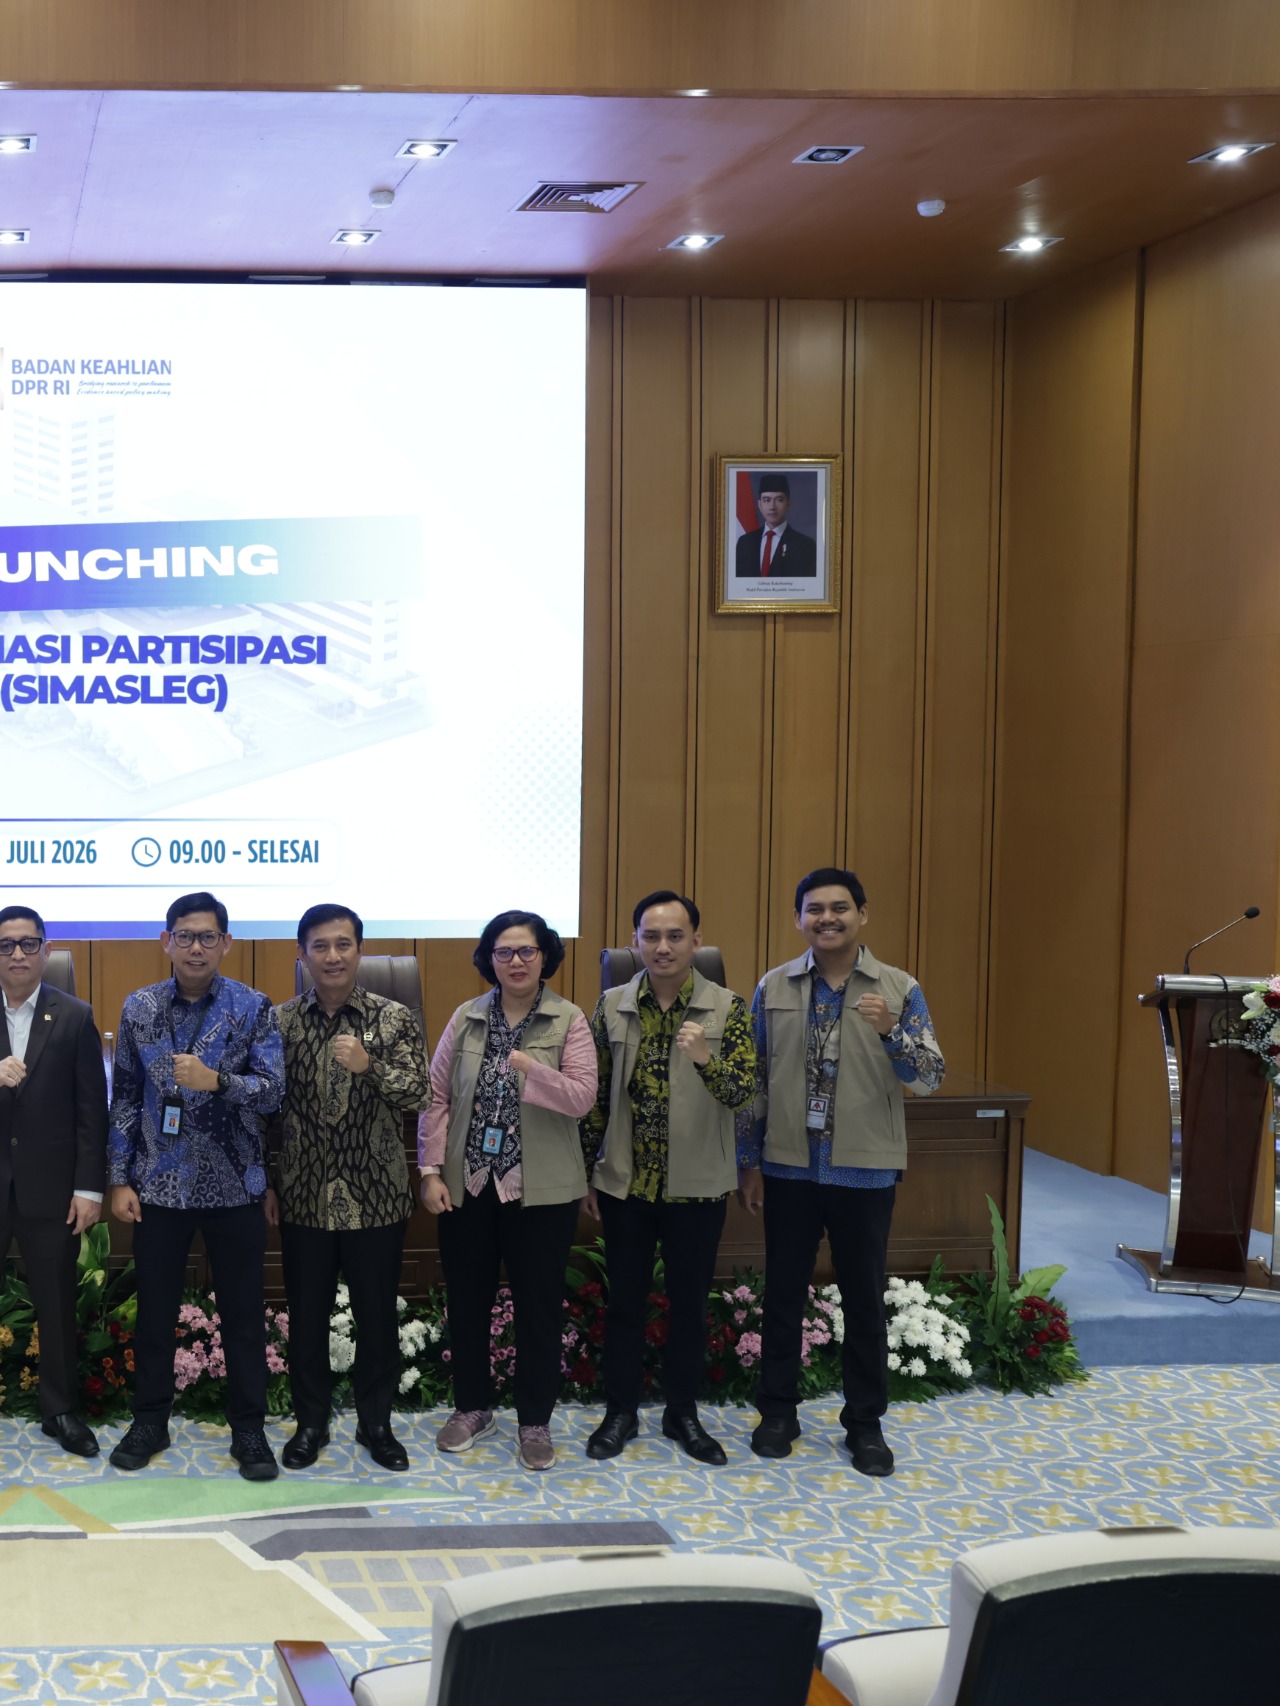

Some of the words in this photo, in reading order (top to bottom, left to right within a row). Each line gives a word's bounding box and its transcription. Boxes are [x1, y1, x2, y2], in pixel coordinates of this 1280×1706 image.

[11, 359, 75, 375] BADAN
[80, 359, 172, 375] KEAHLIAN
[11, 379, 49, 395] DPR
[53, 379, 70, 395] RI
[81, 634, 327, 665] PARTISIPASI
[0, 673, 228, 713] (SIMASLEG)
[5, 840, 46, 865] JULI
[51, 839, 98, 865] 2026
[169, 839, 226, 865] 09.00
[247, 839, 320, 864] SELESAI
